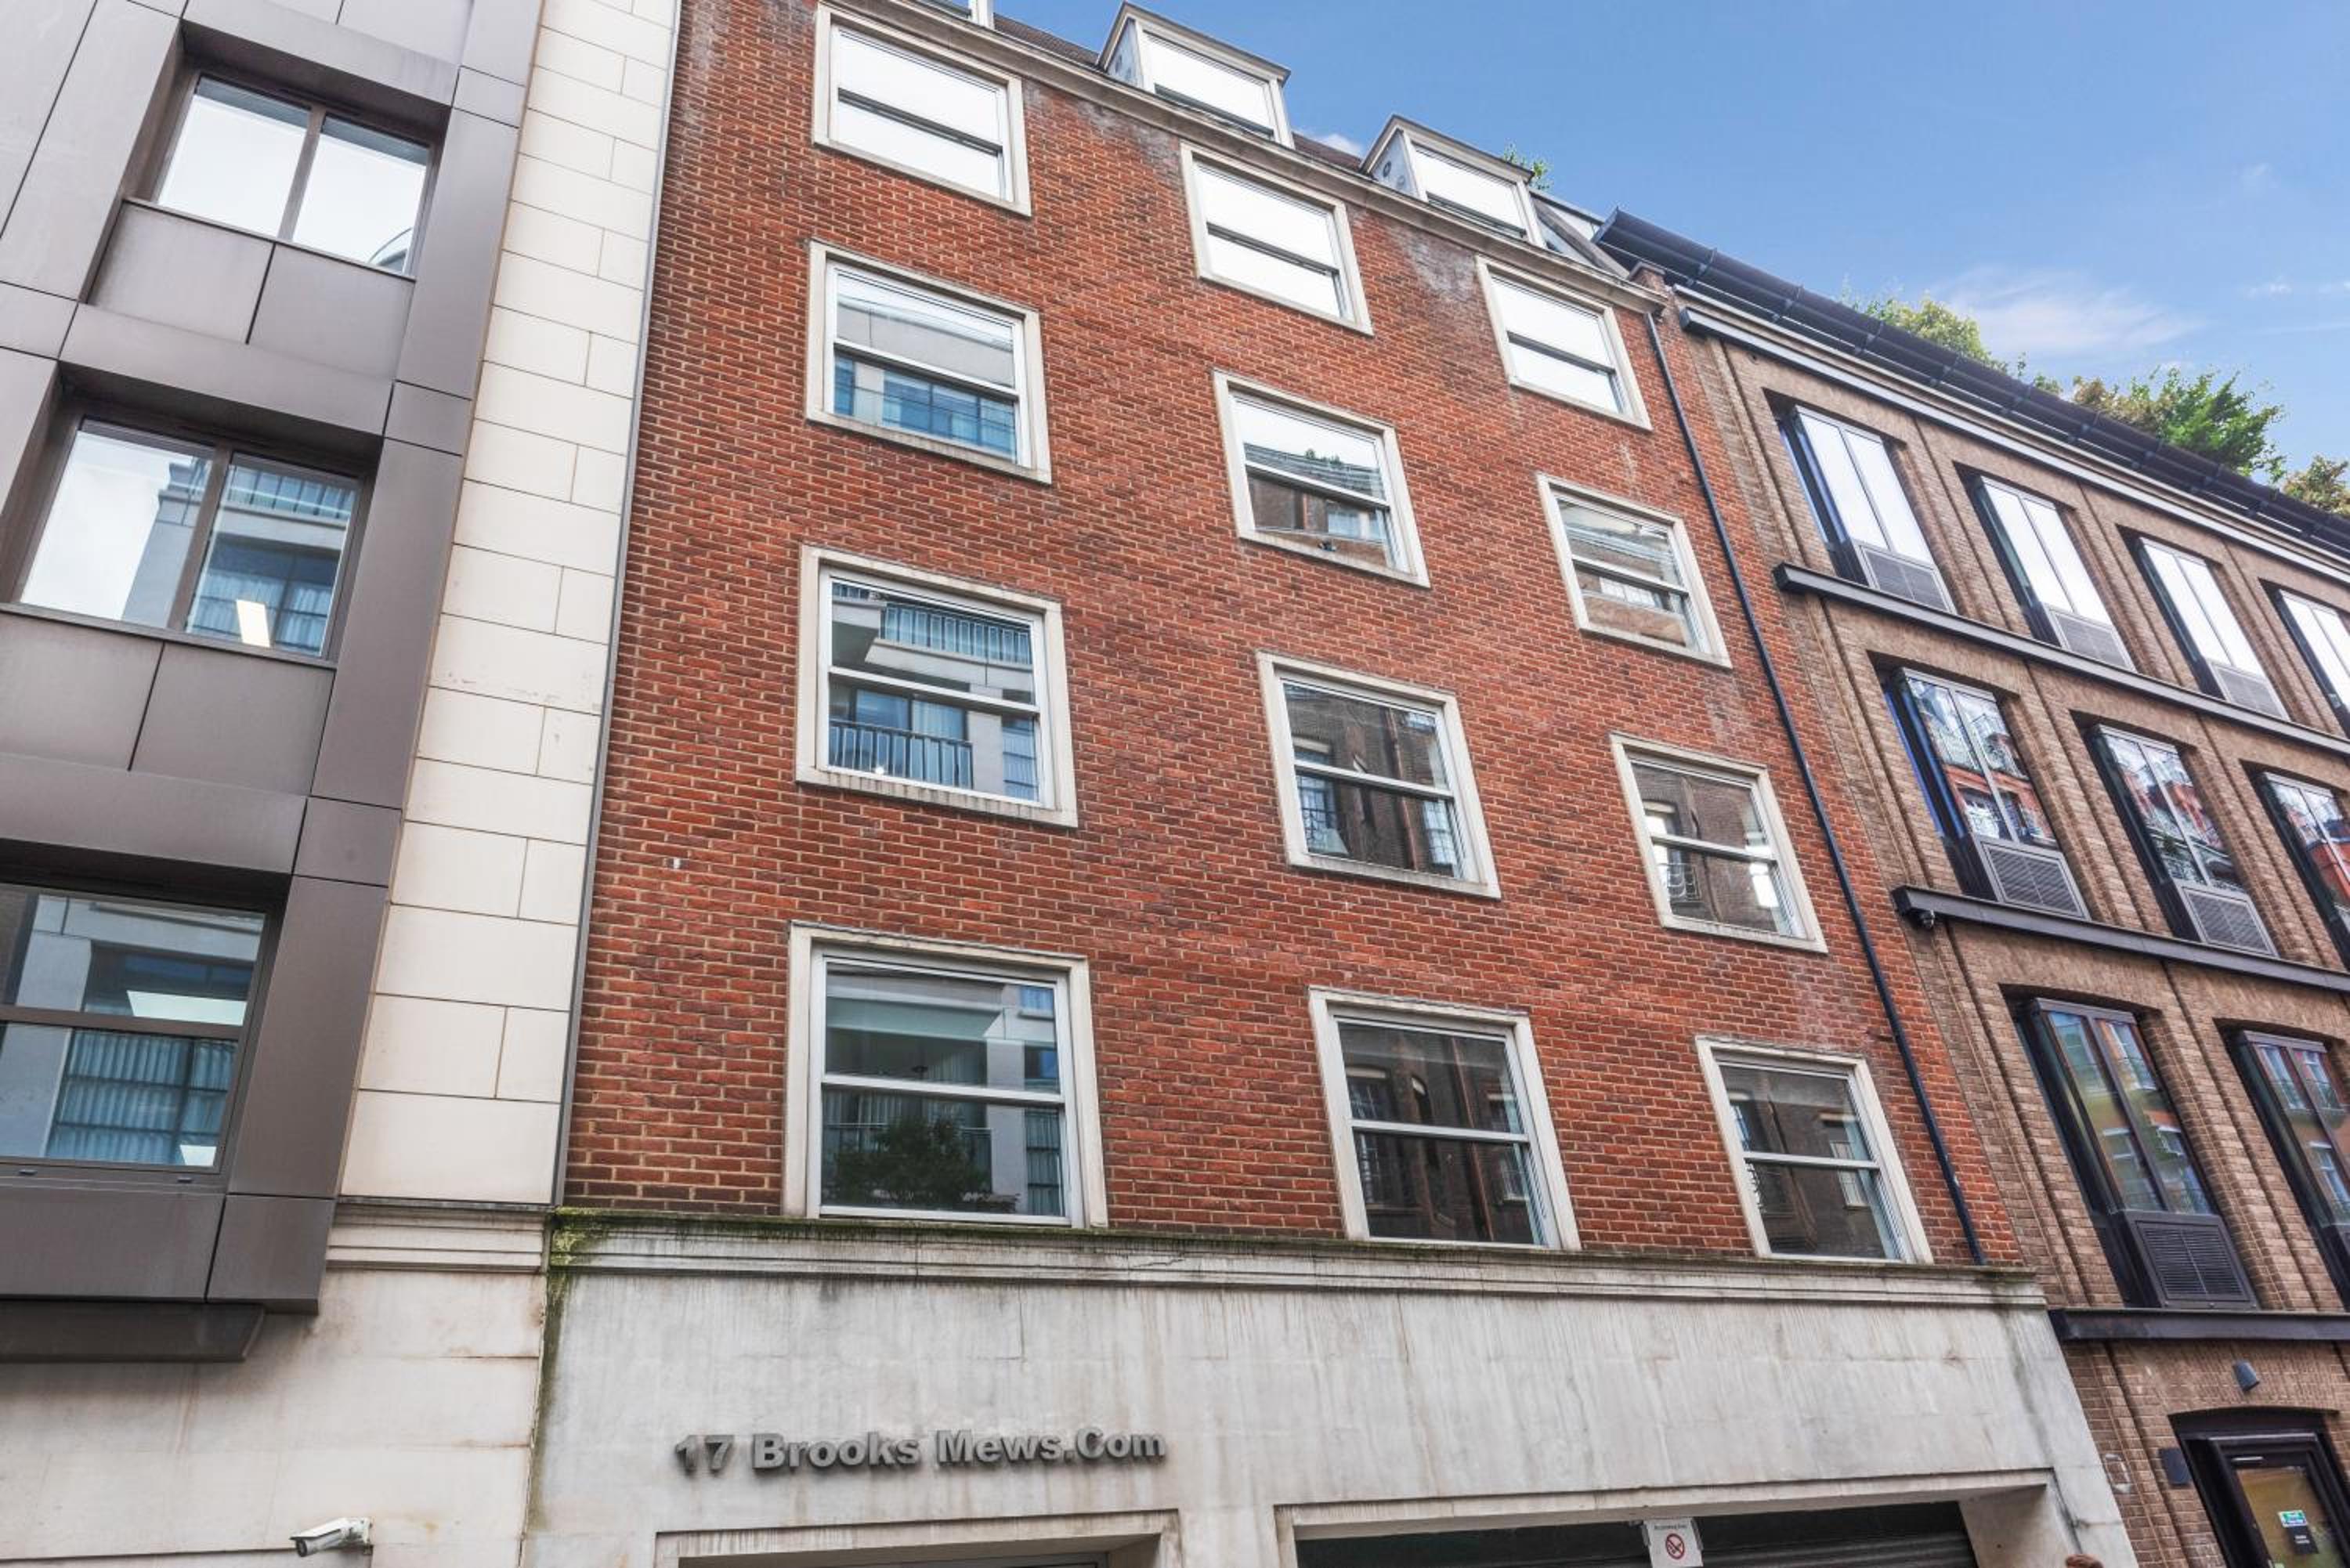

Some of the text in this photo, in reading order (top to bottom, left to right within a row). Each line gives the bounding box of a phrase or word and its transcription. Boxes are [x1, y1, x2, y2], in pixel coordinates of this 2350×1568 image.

[674, 1427, 1166, 1472] 17 Brooks Mews.Com
